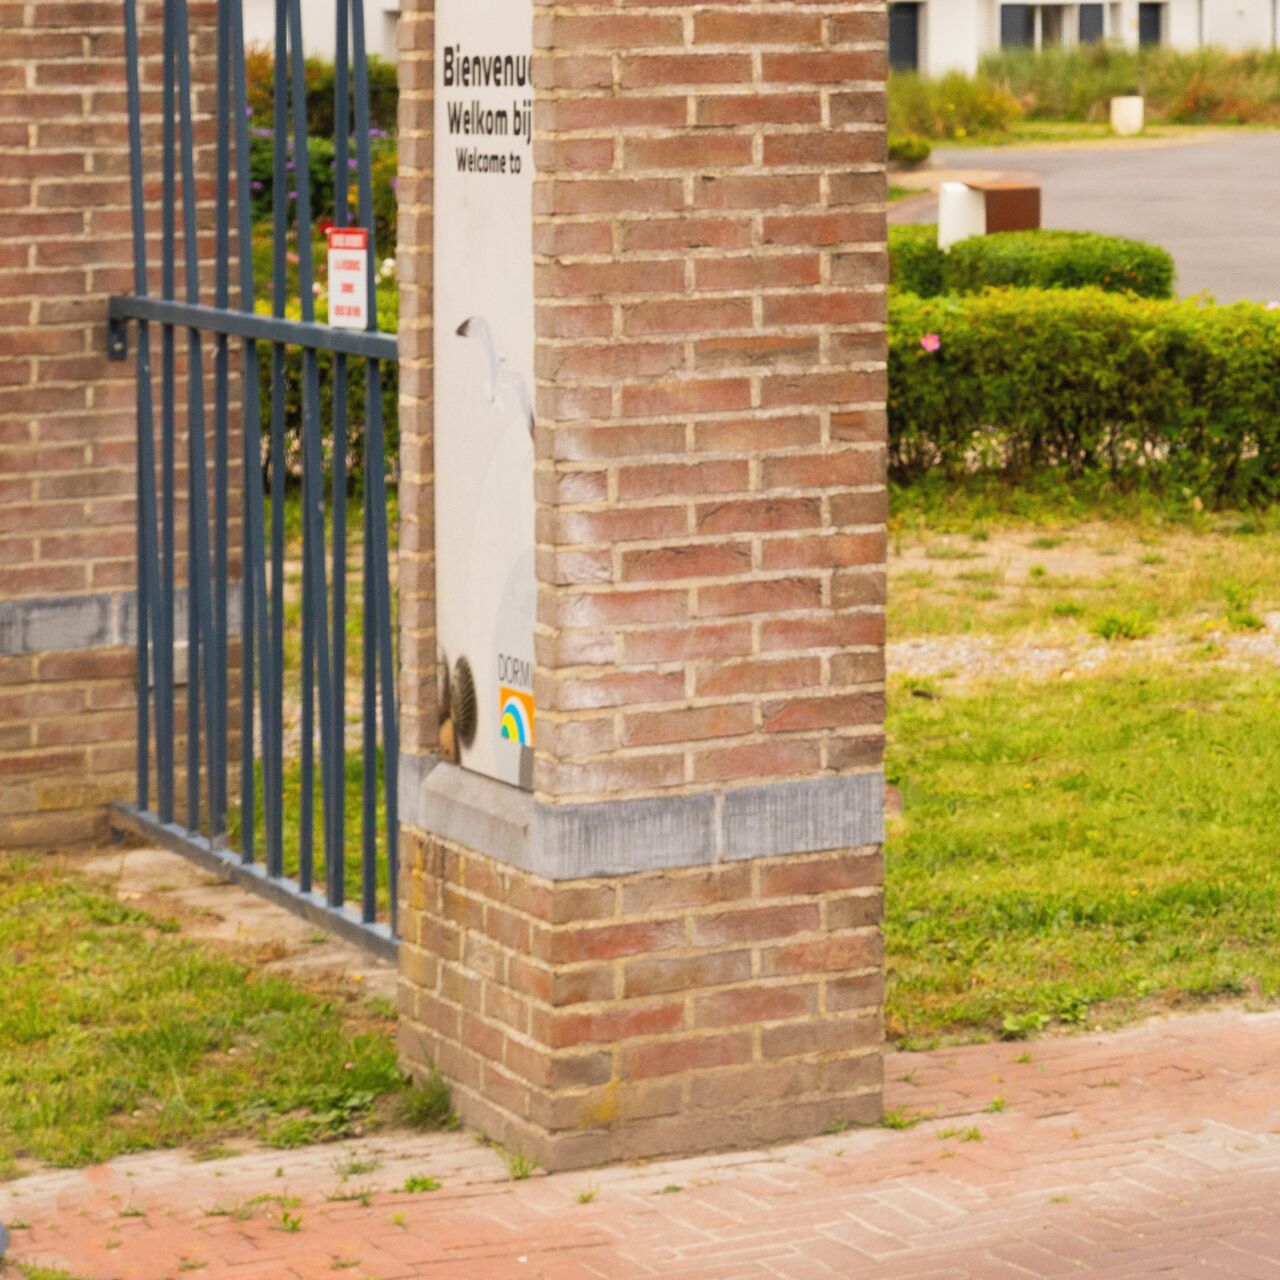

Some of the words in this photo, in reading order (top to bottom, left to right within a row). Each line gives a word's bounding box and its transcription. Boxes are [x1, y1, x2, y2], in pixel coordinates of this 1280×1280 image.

[447, 100, 508, 135] Welkom
[513, 99, 532, 145] bij
[456, 146, 506, 174] Welcome
[509, 150, 521, 174] to
